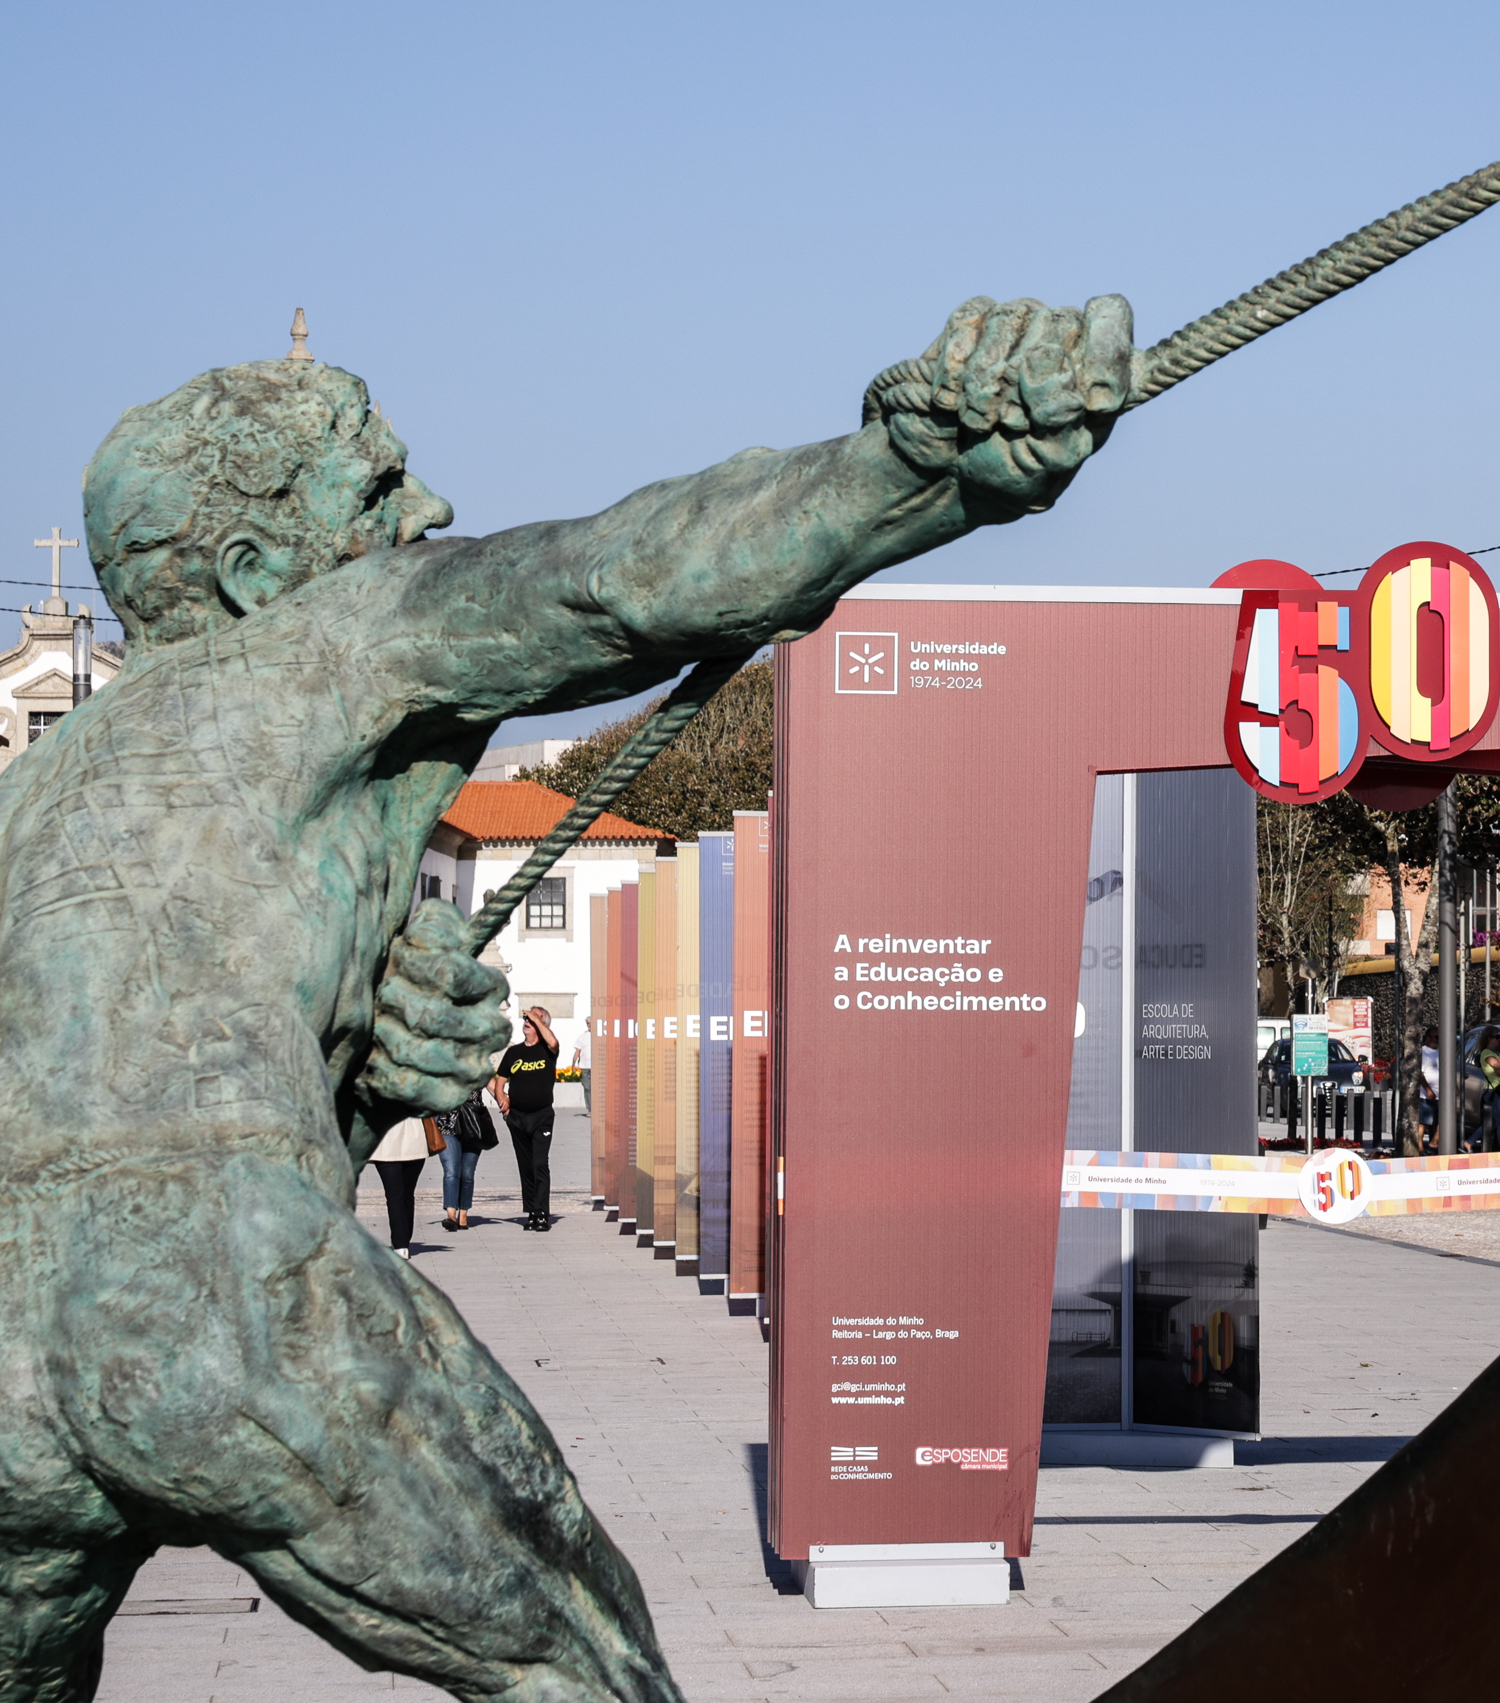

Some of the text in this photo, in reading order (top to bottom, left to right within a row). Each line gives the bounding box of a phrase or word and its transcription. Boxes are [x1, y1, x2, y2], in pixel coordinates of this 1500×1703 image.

[910, 641, 1007, 655] Universidade
[909, 658, 979, 672] do Minho
[909, 675, 983, 689] 1974-2024
[1238, 557, 1490, 794] 50
[833, 933, 992, 955] A reinventar
[833, 961, 1004, 987] a Educação e
[833, 990, 1047, 1012] o Conhecimento
[1142, 1003, 1194, 1018] ESCOLA DE
[1141, 1024, 1209, 1040] ARQUITETURA,
[1141, 1045, 1211, 1060] ARTE E DESIGN
[521, 1059, 546, 1071] asics
[1088, 1175, 1133, 1185] Universidade
[1145, 1177, 1167, 1185] Minho
[1200, 1178, 1235, 1187] 1974-2024
[1310, 1159, 1363, 1212] 50
[1457, 1177, 1500, 1186] Universidade
[832, 1315, 925, 1326] Universidade do Minho
[832, 1329, 863, 1339] Reitoria
[872, 1329, 896, 1341] Largo
[897, 1329, 909, 1339] do
[910, 1328, 933, 1340] Paço,
[935, 1328, 959, 1340] Braga
[831, 1355, 897, 1366] T. 253 601 100
[831, 1381, 906, 1393] gci@gci.uminho.pt
[830, 1394, 905, 1406] www.uminho.pt
[830, 1465, 869, 1473] REDE CASAS
[981, 1463, 1008, 1471] municipal
[838, 1472, 893, 1480] CONHECIMENTO
